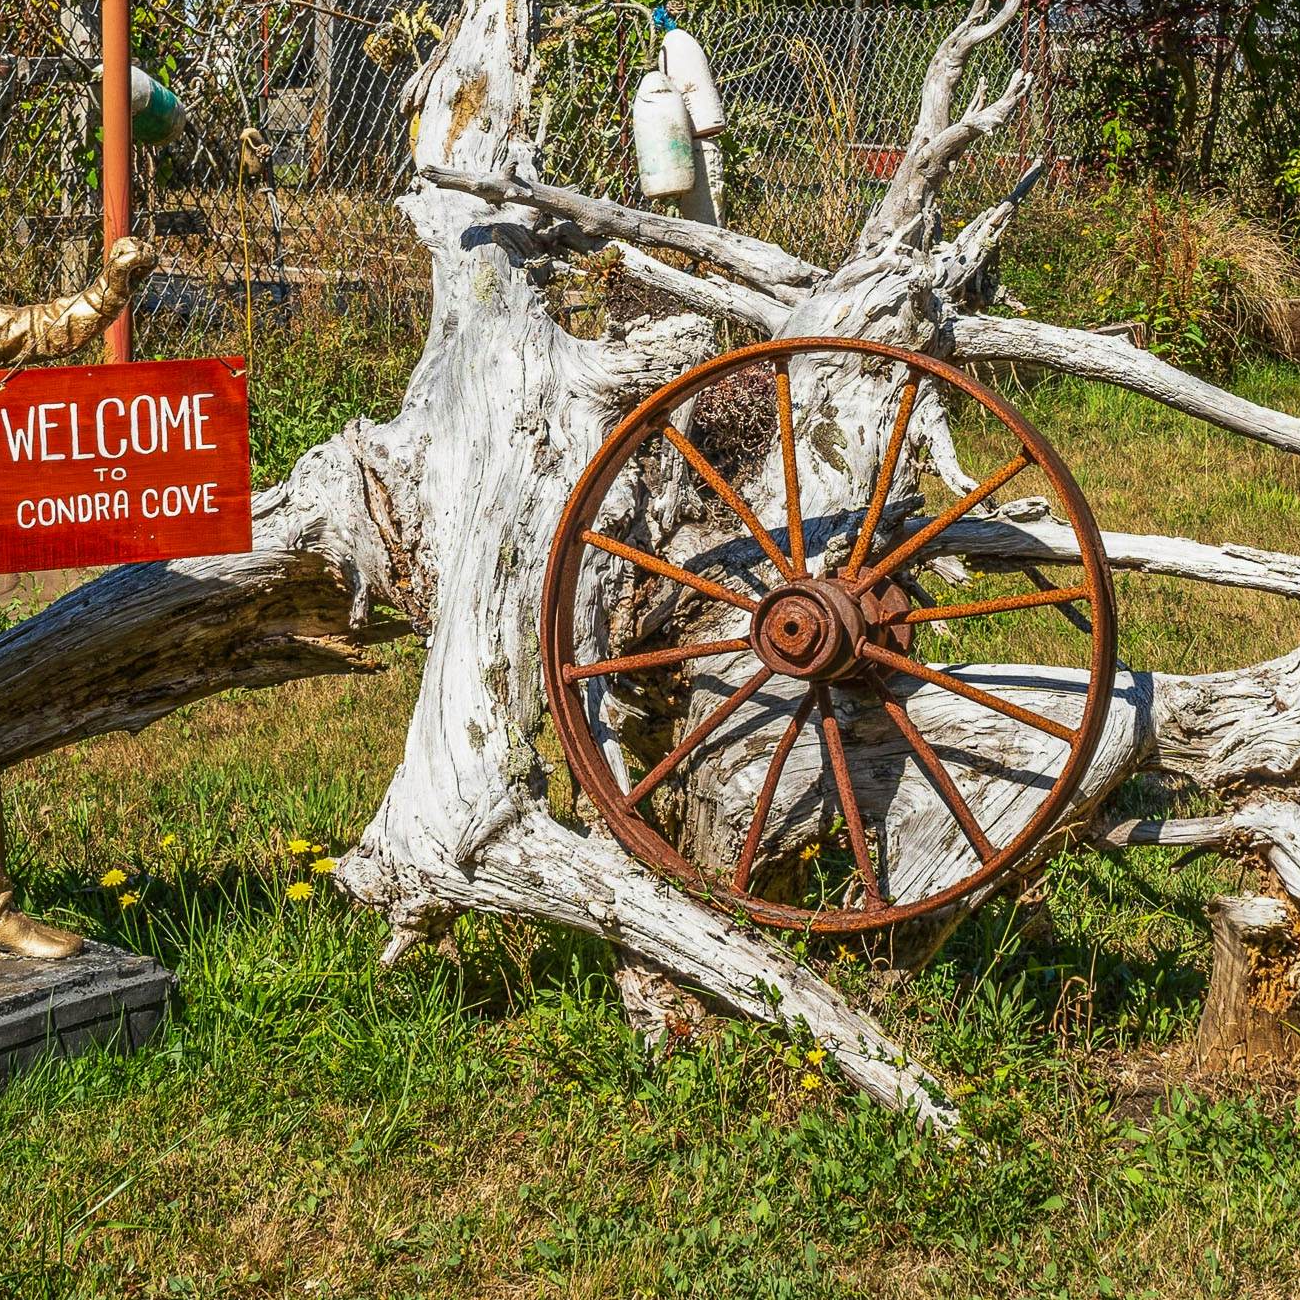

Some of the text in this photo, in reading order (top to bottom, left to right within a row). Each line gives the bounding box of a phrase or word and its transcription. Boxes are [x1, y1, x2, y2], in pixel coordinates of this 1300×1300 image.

[0, 393, 218, 462] WELCOME
[93, 467, 127, 482] TO
[16, 483, 220, 529] CONDRA COVE
